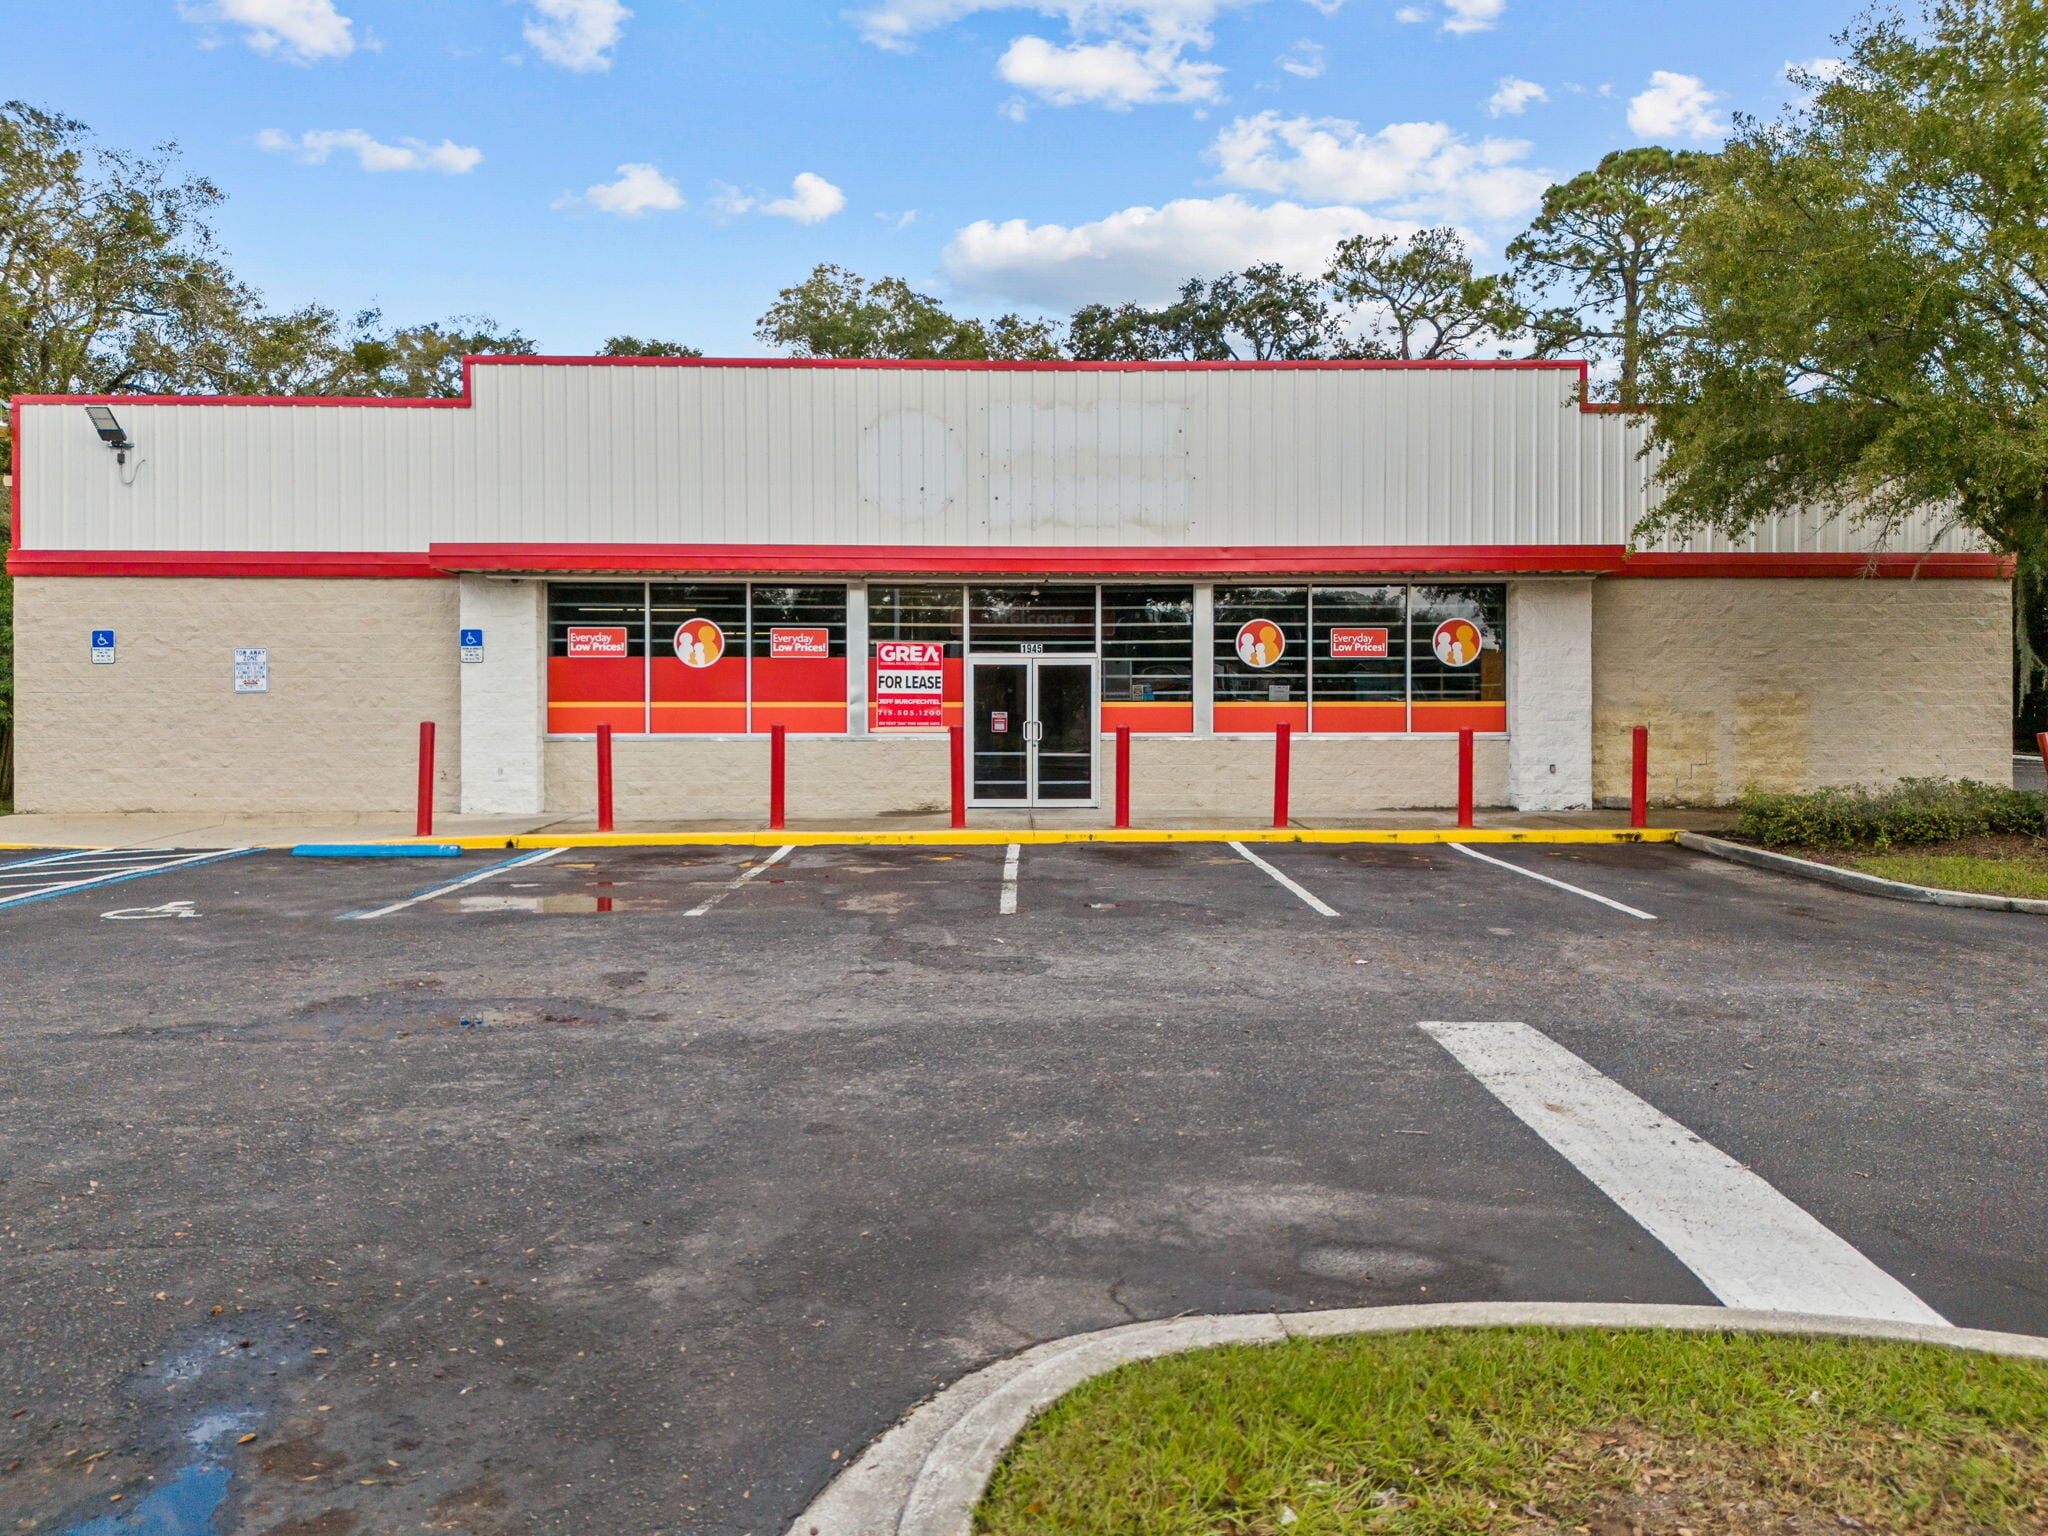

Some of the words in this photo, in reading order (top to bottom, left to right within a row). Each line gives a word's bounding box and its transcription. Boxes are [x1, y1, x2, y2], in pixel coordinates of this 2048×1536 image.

[570, 631, 612, 644] Everyday
[773, 633, 814, 645] Everyday
[1333, 633, 1374, 645] Everyday
[570, 643, 591, 651] Low
[592, 642, 625, 651] Prices!
[773, 643, 793, 652] Low
[794, 643, 826, 652] Prices!
[1022, 644, 1042, 653] 1945
[1333, 643, 1353, 652] Low
[1354, 643, 1385, 652] Prices!
[878, 675, 902, 689] FOR
[905, 675, 942, 689] LEASE
